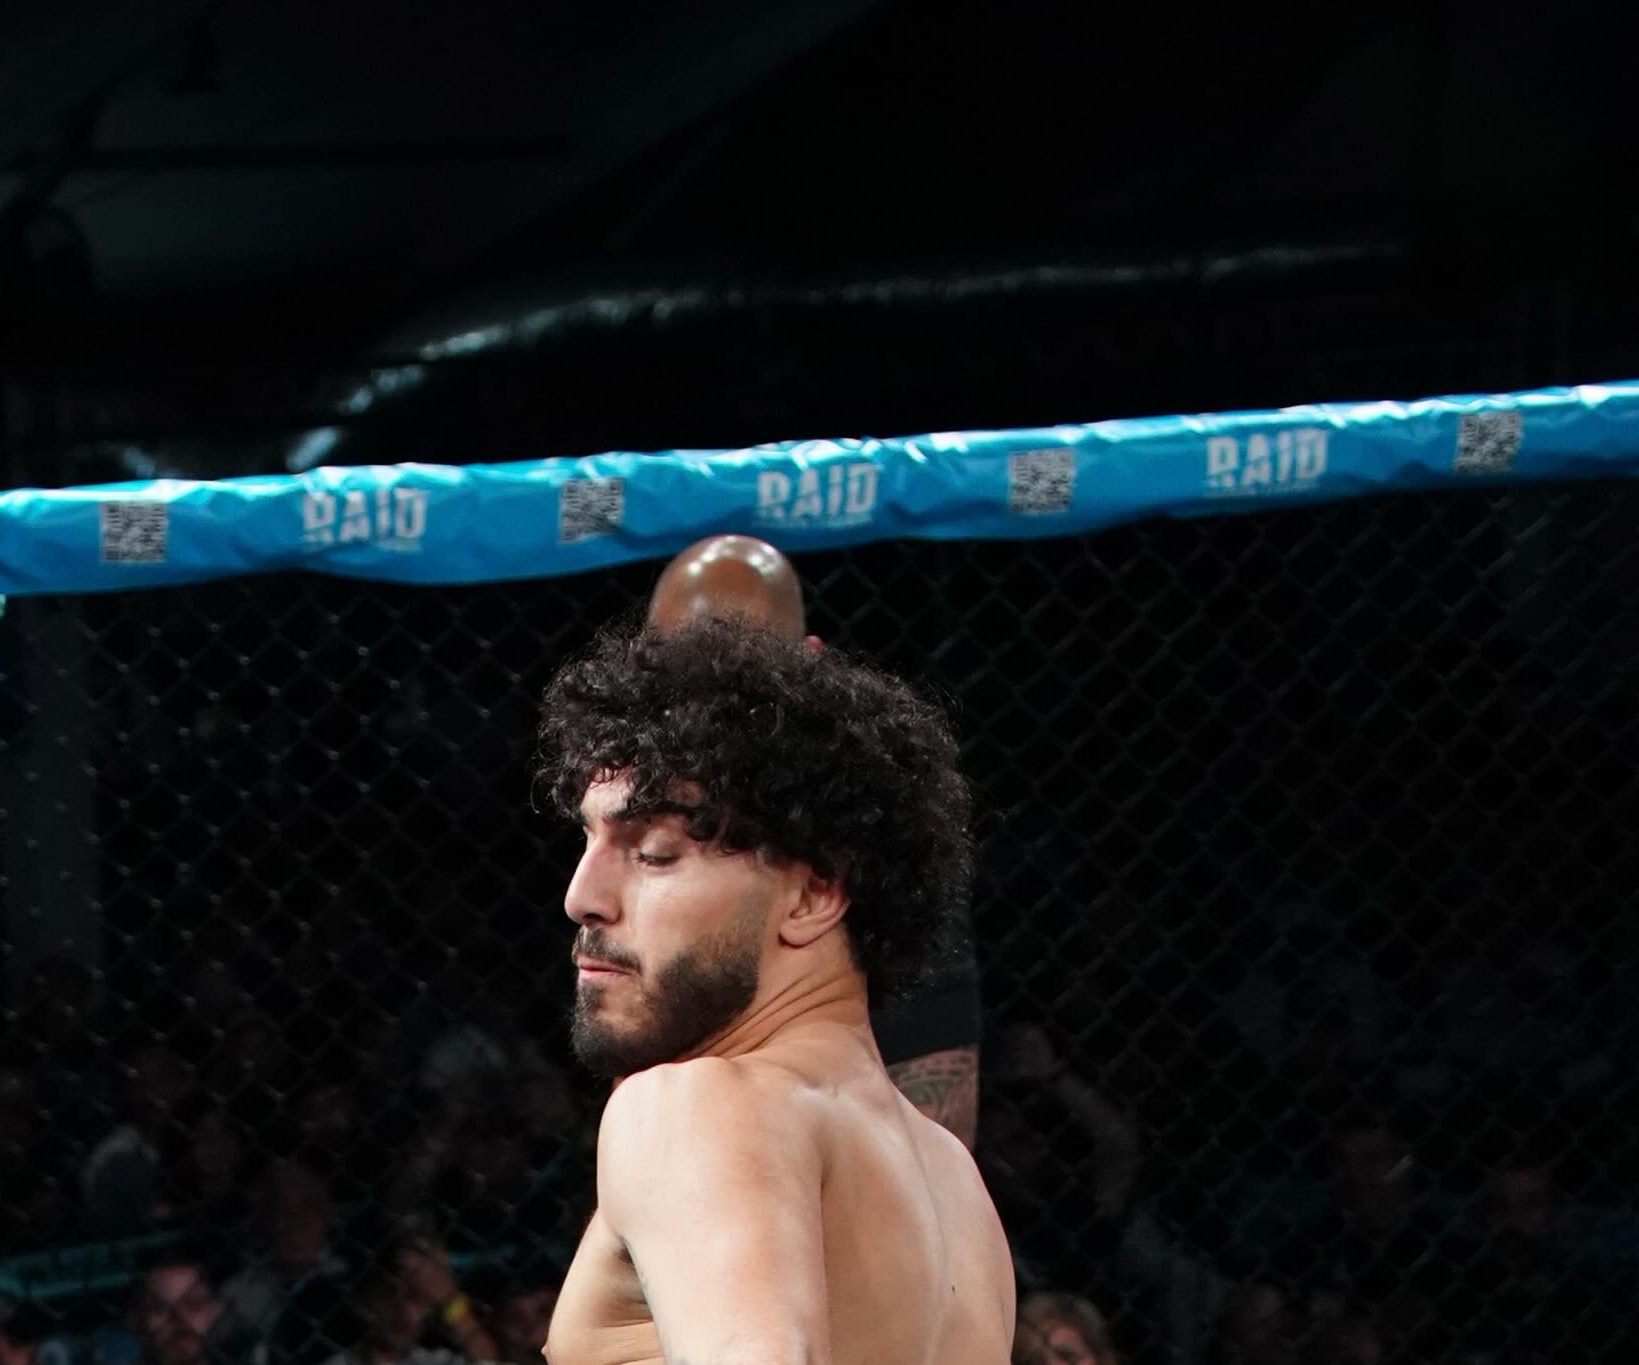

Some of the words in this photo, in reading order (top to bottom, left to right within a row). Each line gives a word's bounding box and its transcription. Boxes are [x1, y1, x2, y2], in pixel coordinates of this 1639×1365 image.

[1206, 428, 1329, 489] RAID
[304, 488, 428, 544] RAID
[758, 463, 877, 518] RAID
